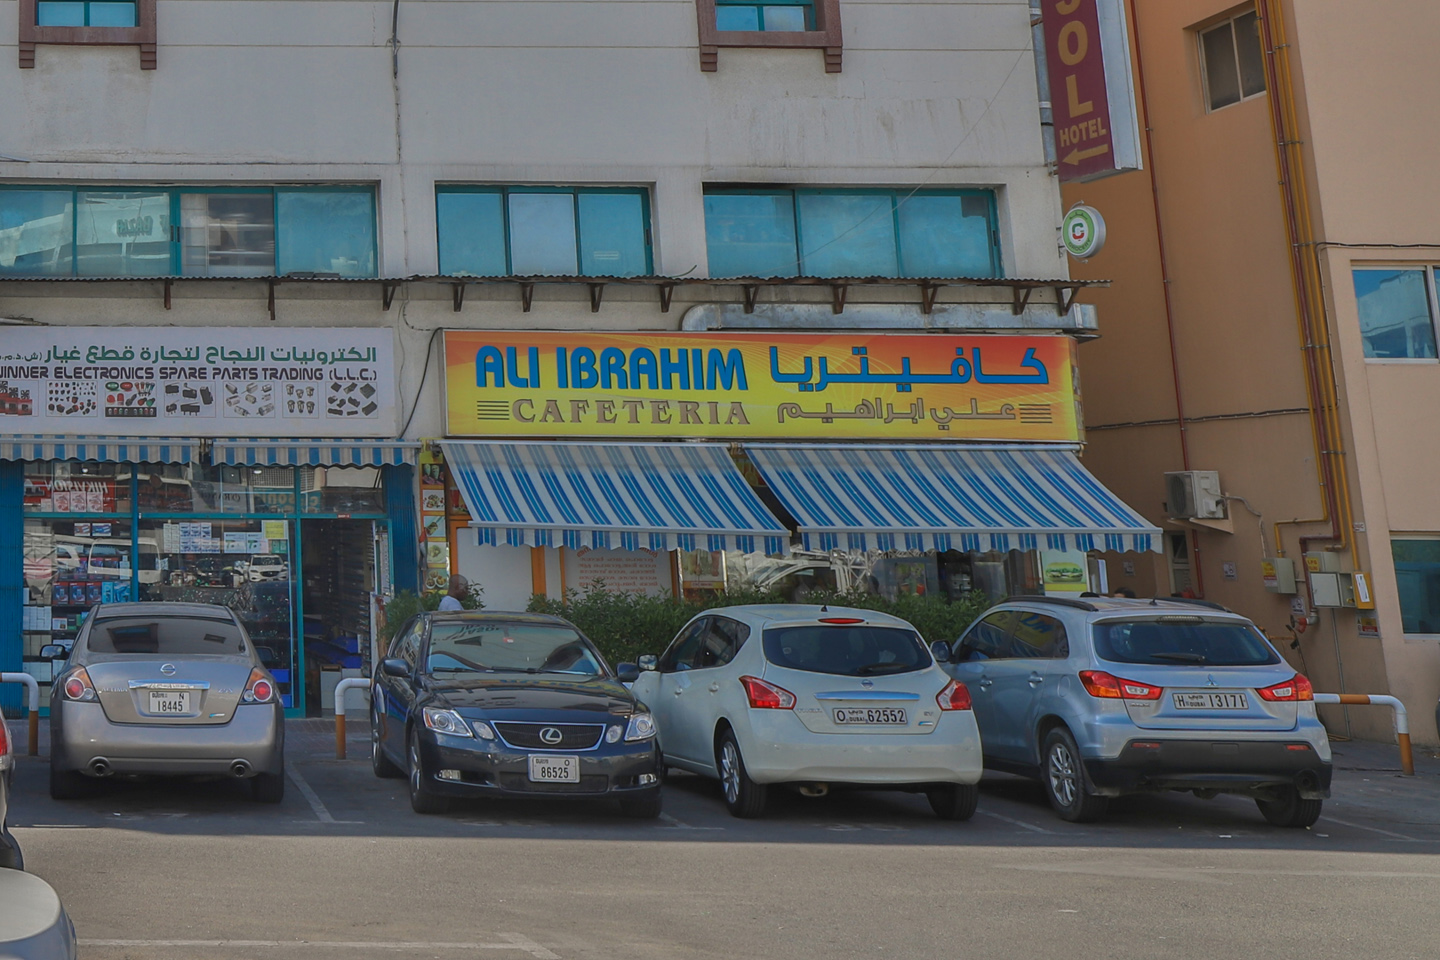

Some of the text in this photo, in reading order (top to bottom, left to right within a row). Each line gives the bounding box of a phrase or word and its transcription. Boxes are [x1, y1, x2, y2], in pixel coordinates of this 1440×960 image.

[1058, 116, 1108, 148] HOTEL
[43, 344, 81, 363] غيار
[85, 345, 133, 363] قطع
[139, 344, 200, 363] لتجارة
[205, 344, 265, 363] النجاح
[270, 345, 377, 363] الكترونيات
[54, 366, 155, 380] ELECTRONICS
[159, 367, 208, 380] SPARE
[212, 367, 259, 380] PARTS
[262, 368, 324, 381] TRADING
[475, 345, 749, 391] ALI IBRAHIM
[768, 345, 1051, 393] كافيتريا
[511, 397, 751, 425] CAFETERIA
[777, 397, 1017, 431] علي ابراهيم
[157, 700, 183, 712] 18445
[1177, 694, 1245, 707] H 13171
[867, 710, 906, 723] 62552
[541, 766, 569, 779] 86525
